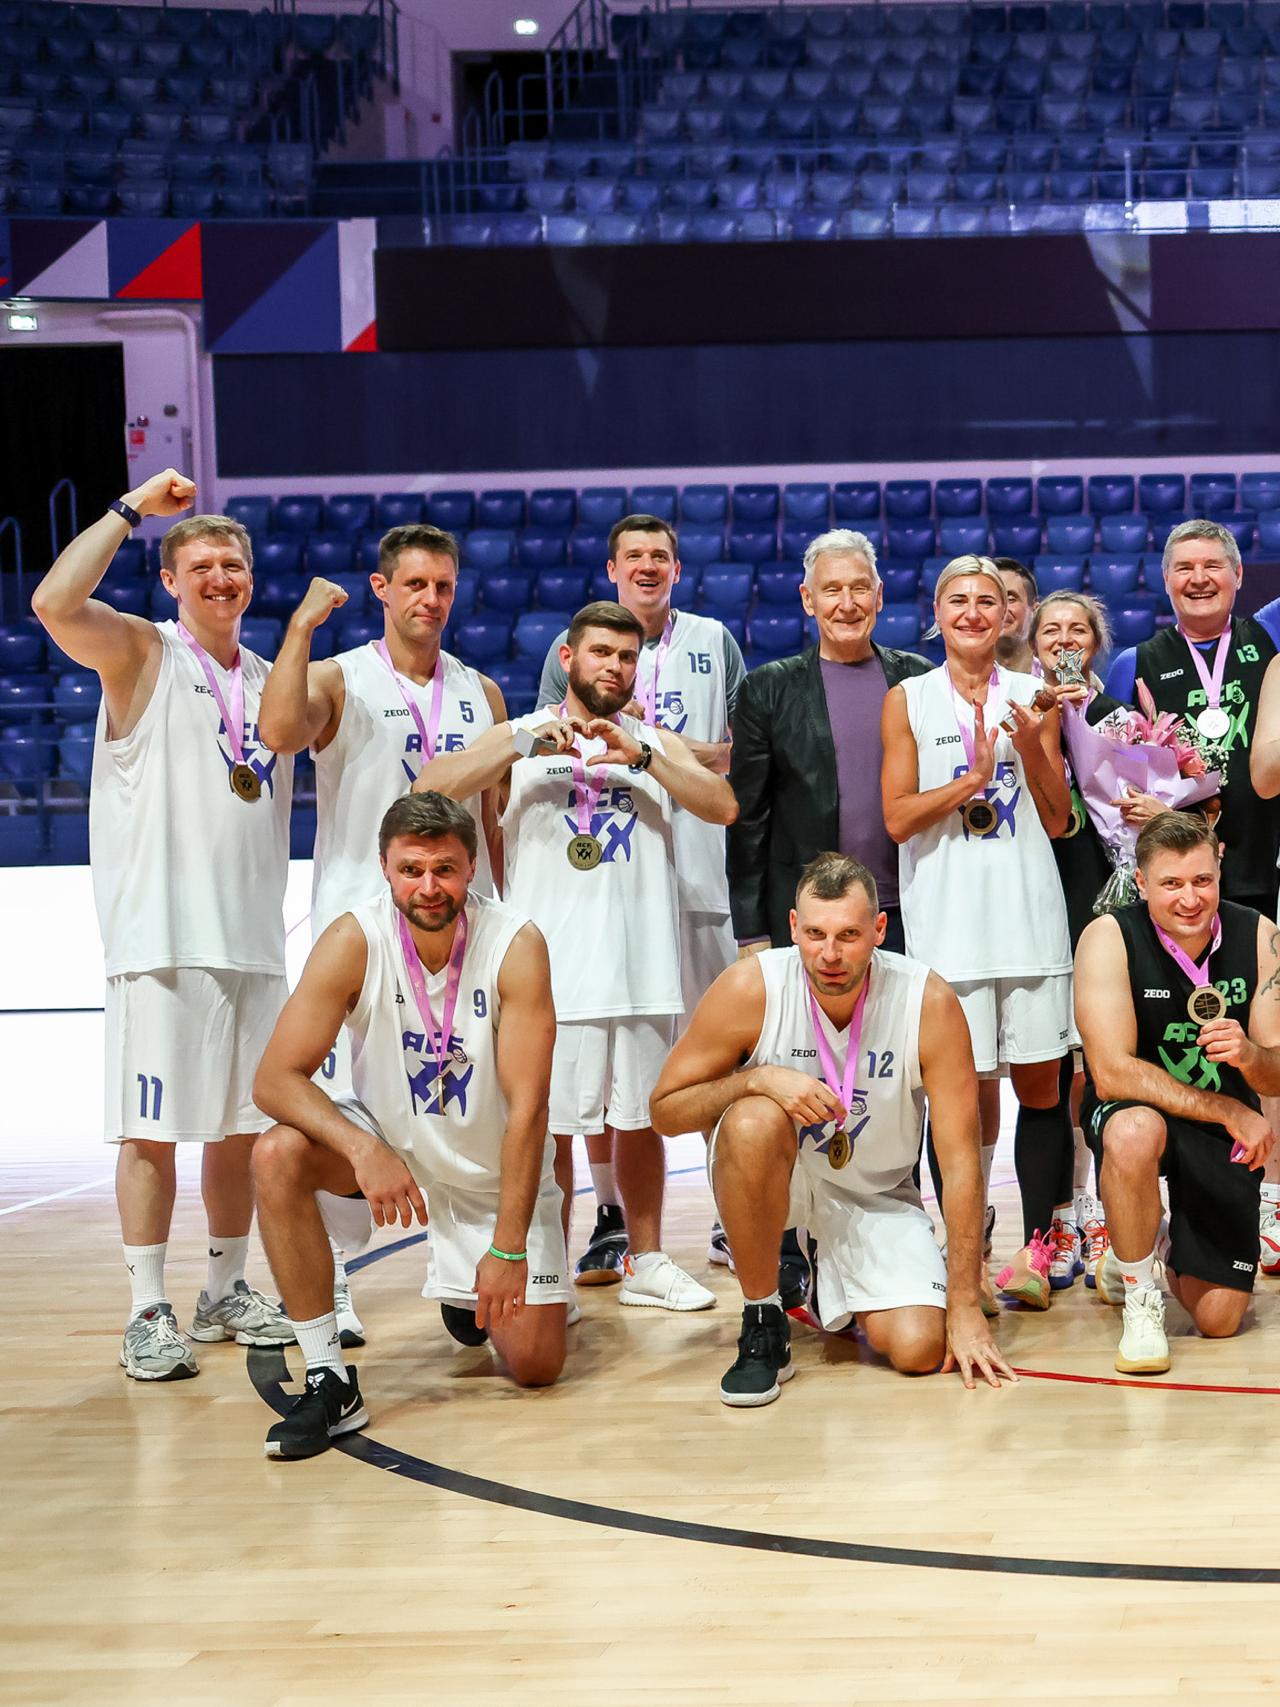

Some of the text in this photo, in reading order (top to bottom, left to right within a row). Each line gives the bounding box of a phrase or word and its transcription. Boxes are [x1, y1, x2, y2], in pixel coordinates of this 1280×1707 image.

[1236, 644, 1260, 663] 13
[687, 651, 712, 674] 15
[1160, 668, 1184, 681] ZEDO
[384, 708, 410, 718] ZEDO
[459, 700, 474, 723] 5
[935, 734, 961, 746] ZEDO
[546, 766, 573, 775] ZEDO
[1143, 988, 1171, 999] ZEDO
[1214, 977, 1248, 1007] 23
[473, 988, 488, 1018] 9
[1163, 1022, 1199, 1043] АС
[792, 1049, 817, 1058] ZEDO
[867, 1050, 894, 1078] 12
[136, 1073, 164, 1121] 11
[1232, 1260, 1254, 1273] ZEDO
[532, 1275, 560, 1285] ZEDO
